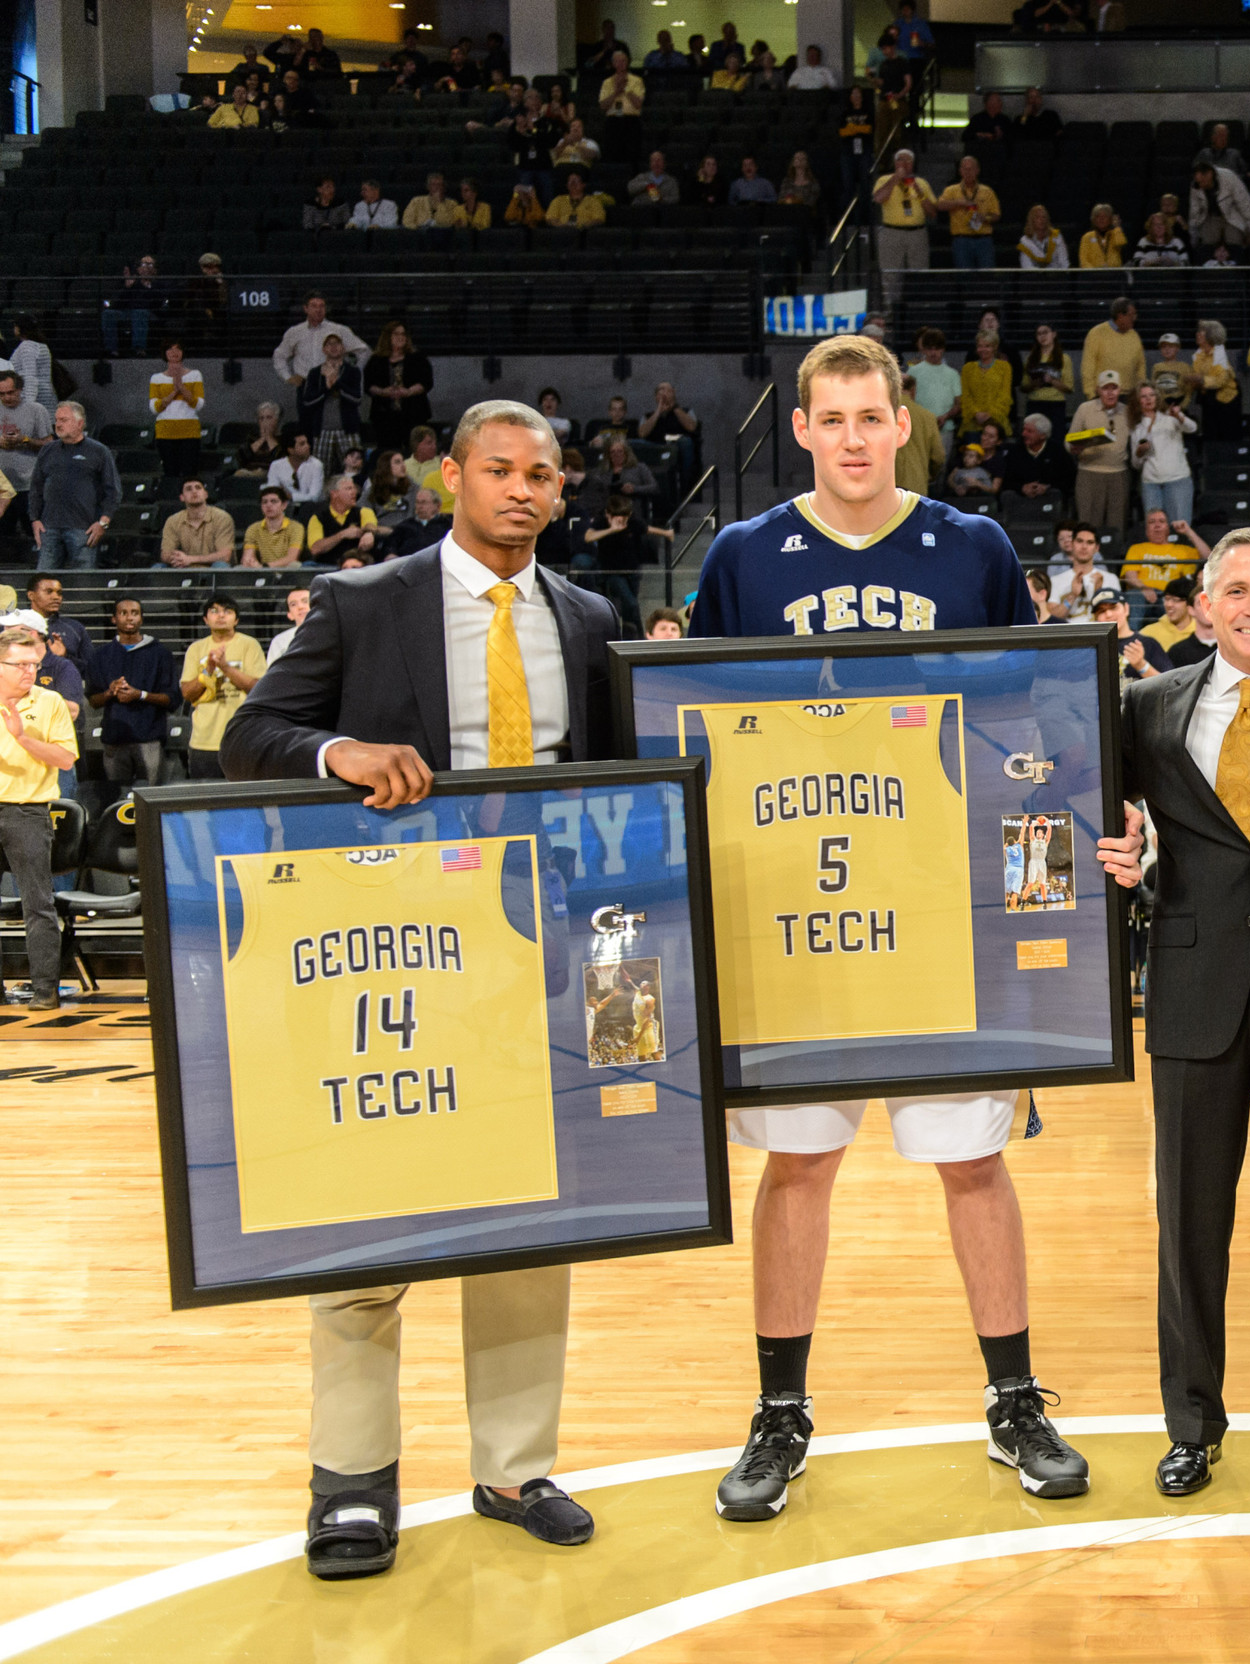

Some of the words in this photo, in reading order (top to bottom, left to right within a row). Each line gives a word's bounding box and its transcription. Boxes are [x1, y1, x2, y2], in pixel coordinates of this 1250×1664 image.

[239, 291, 269, 306] 108
[784, 585, 936, 636] TECH
[1003, 752, 1054, 784] GT
[753, 773, 906, 828] GEORGIA
[817, 834, 851, 894] 5
[293, 924, 464, 986] GEORGIA
[775, 909, 897, 956] TECH
[352, 986, 418, 1055] 14
[320, 1066, 458, 1124] TECH
